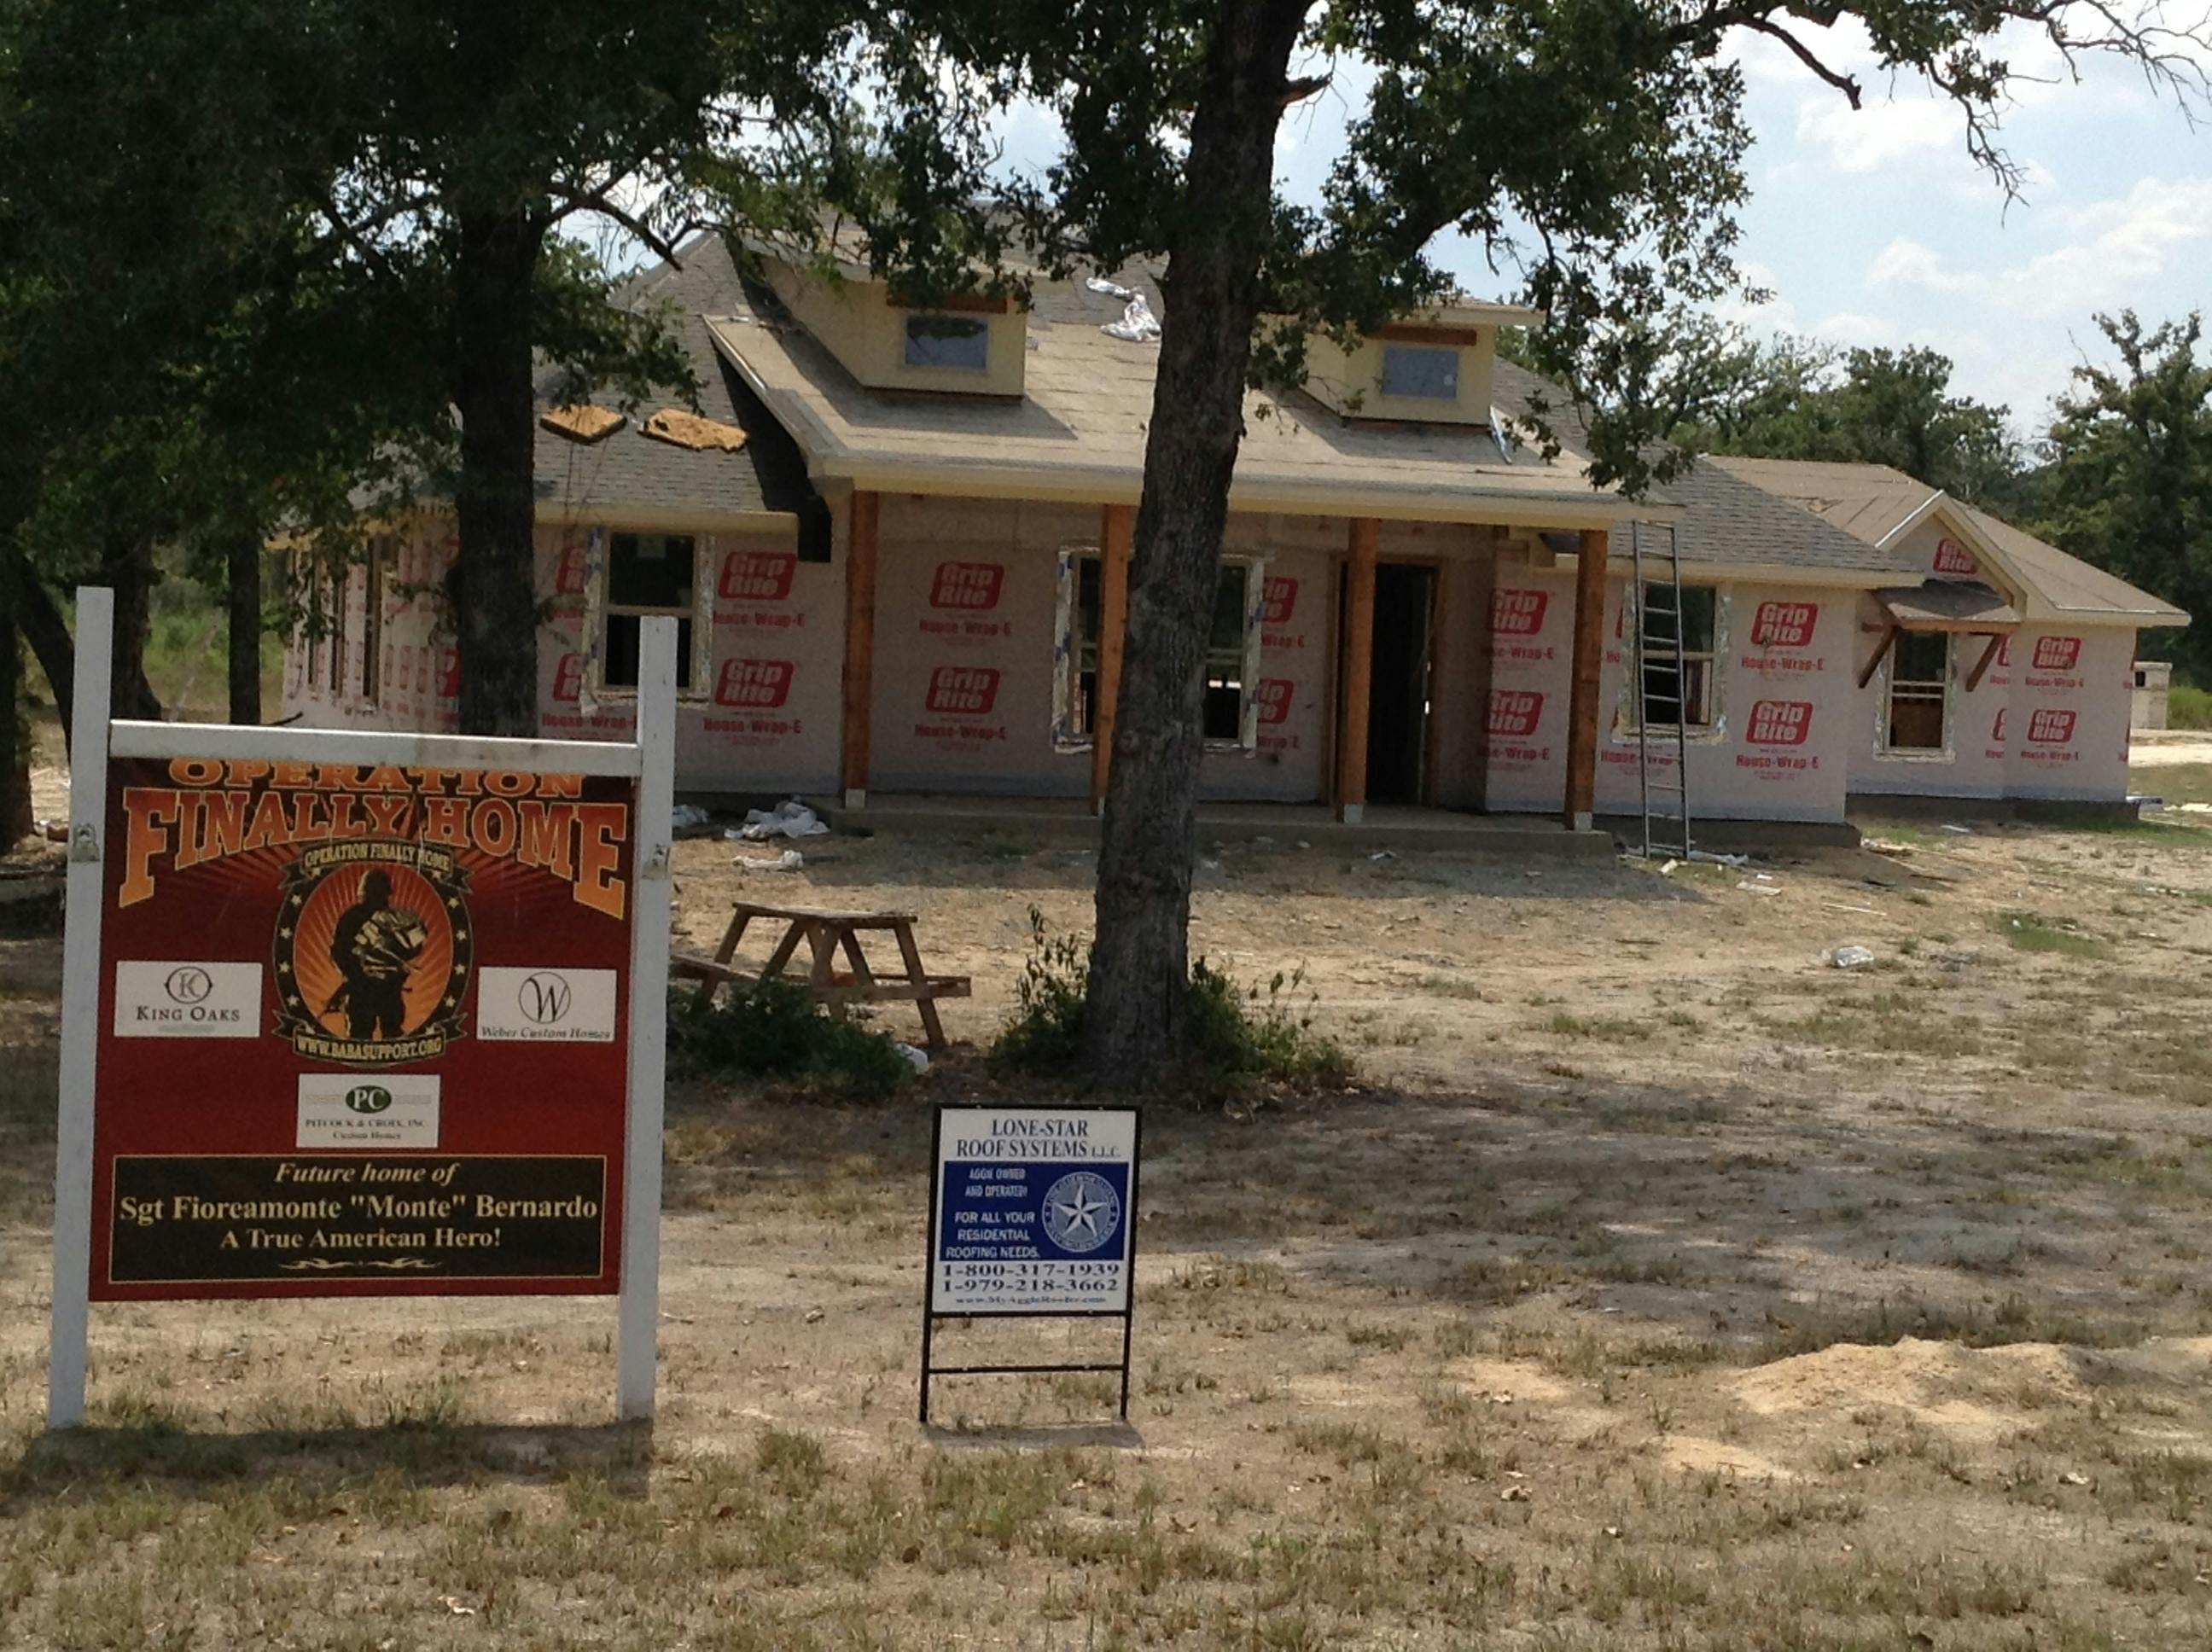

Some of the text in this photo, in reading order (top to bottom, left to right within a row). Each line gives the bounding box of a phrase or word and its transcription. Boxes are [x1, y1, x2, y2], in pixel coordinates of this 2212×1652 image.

[730, 554, 787, 577] Grip
[940, 564, 994, 586] Grip
[726, 576, 779, 596] Rite
[938, 585, 987, 605] Rite
[1761, 603, 1809, 625] Grip
[1759, 623, 1802, 642] Rite
[2040, 637, 2075, 654] Grip
[726, 660, 783, 685] Grip
[937, 668, 990, 691] Grip
[724, 683, 776, 703] Rite
[934, 689, 983, 709] Rite
[1756, 701, 1804, 724] Grip
[2035, 711, 2070, 727] Grip
[1754, 722, 1797, 741] Rite
[2033, 725, 2065, 741] Rite
[169, 759, 583, 799] OPERATION
[119, 787, 626, 920] FINALLY HOME
[305, 841, 451, 872] OPERATION FINALLY HOME
[179, 972, 201, 998] K
[481, 1026, 611, 1039] Weber Custom Homes
[352, 1088, 387, 1110] PC
[992, 1118, 1089, 1137] LONE-STAR
[956, 1138, 1006, 1158] ROOF
[1008, 1139, 1088, 1158] SYSTEMS
[273, 1162, 462, 1187] Future home of
[119, 1194, 597, 1227] Sgt Fioreamonte "Monte" Bernardo
[954, 1211, 1036, 1224] FOR ALL YOUR
[219, 1227, 502, 1249] A True American Hero!
[958, 1228, 1031, 1242] RESIDENTIAL
[945, 1246, 998, 1259] ROOFING
[943, 1263, 1121, 1277] 1-800-317-1939
[943, 1278, 1120, 1293] 1-979-218-3662
